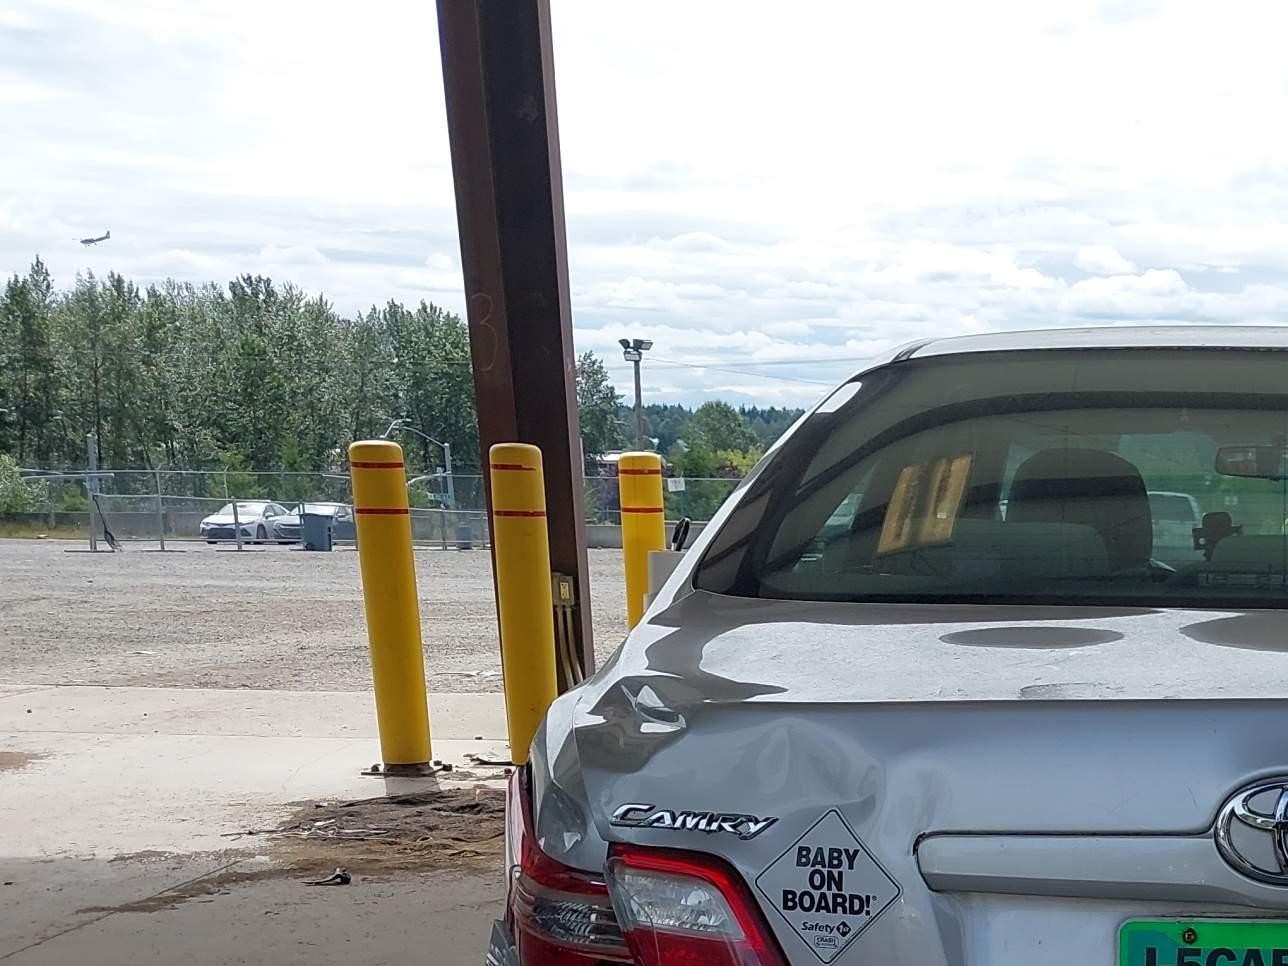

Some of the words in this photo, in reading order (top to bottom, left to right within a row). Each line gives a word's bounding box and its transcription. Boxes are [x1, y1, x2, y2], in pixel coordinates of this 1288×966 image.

[610, 803, 780, 841] CAMRY
[796, 846, 860, 870] BABY
[808, 869, 844, 892] ON
[782, 889, 872, 916] BOARD!
[801, 922, 835, 934] Safety
